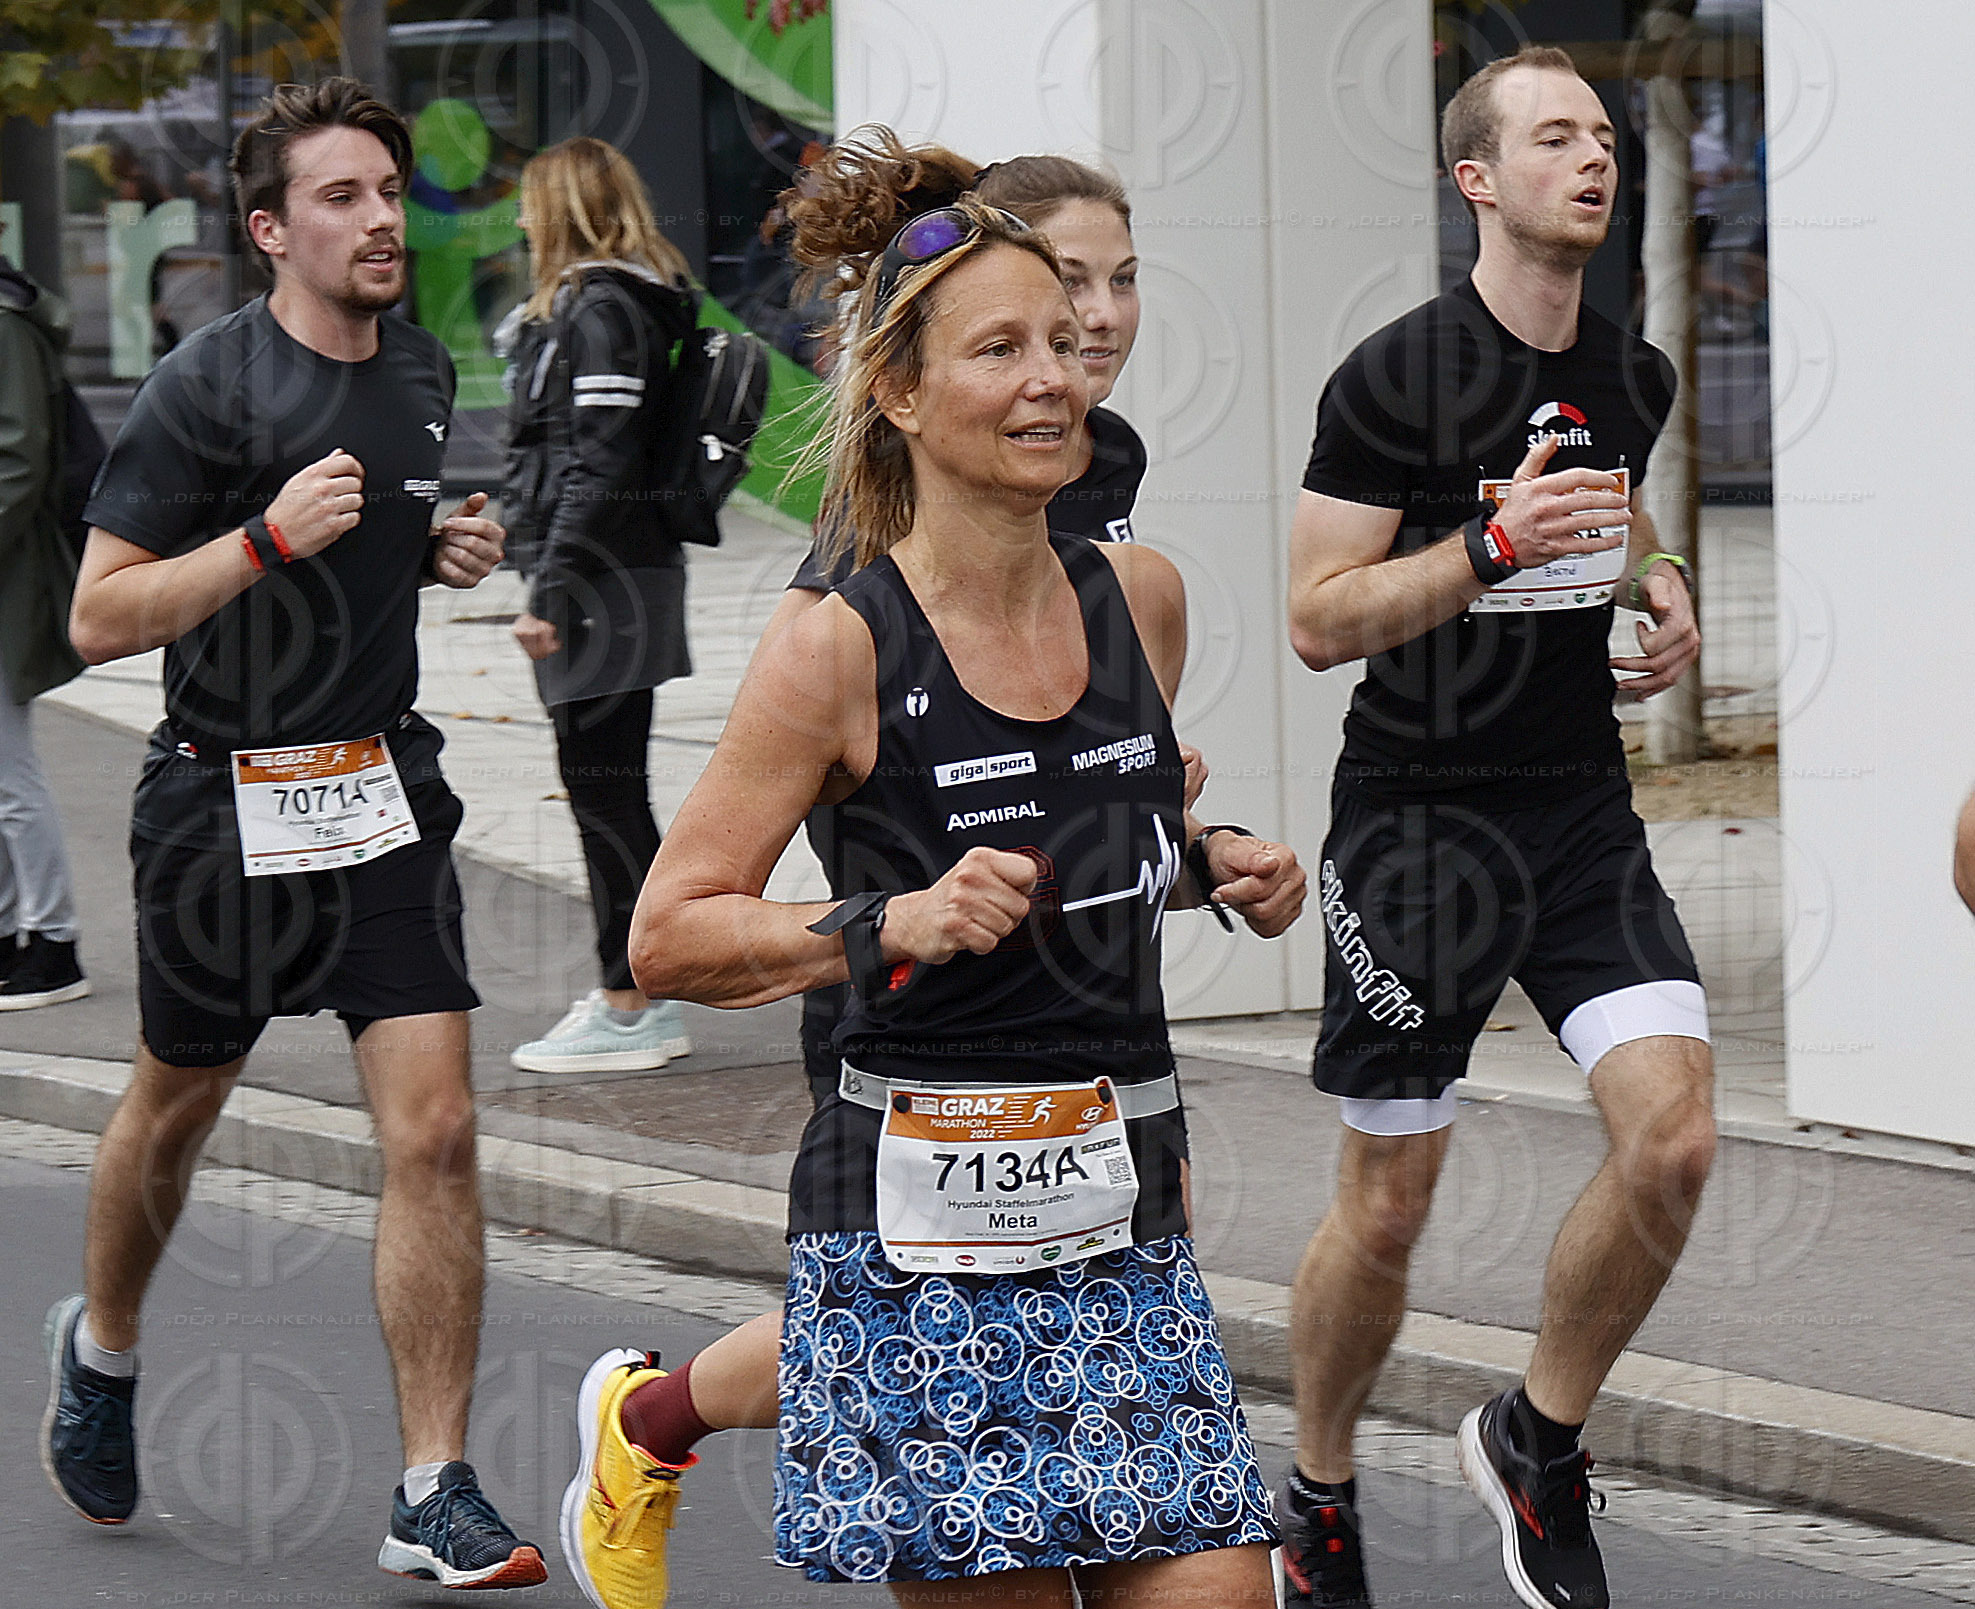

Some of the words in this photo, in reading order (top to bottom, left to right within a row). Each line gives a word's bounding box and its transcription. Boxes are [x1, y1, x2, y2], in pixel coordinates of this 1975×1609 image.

[1071, 733, 1156, 771] MAGNESIUM
[1117, 750, 1158, 775] SPORT
[949, 764, 984, 782] giga
[990, 756, 1031, 774] sport
[272, 779, 368, 816] 7071A
[946, 800, 1046, 832] ADMIRAL
[941, 1097, 1006, 1117] GRAZ
[930, 1118, 988, 1129] MARATHON
[969, 1129, 996, 1139] 2022
[931, 1146, 1090, 1192] 7134A
[948, 1198, 992, 1210] Hyundai
[994, 1192, 1075, 1209] Staffelmarathon
[988, 1212, 1038, 1230] Meta
